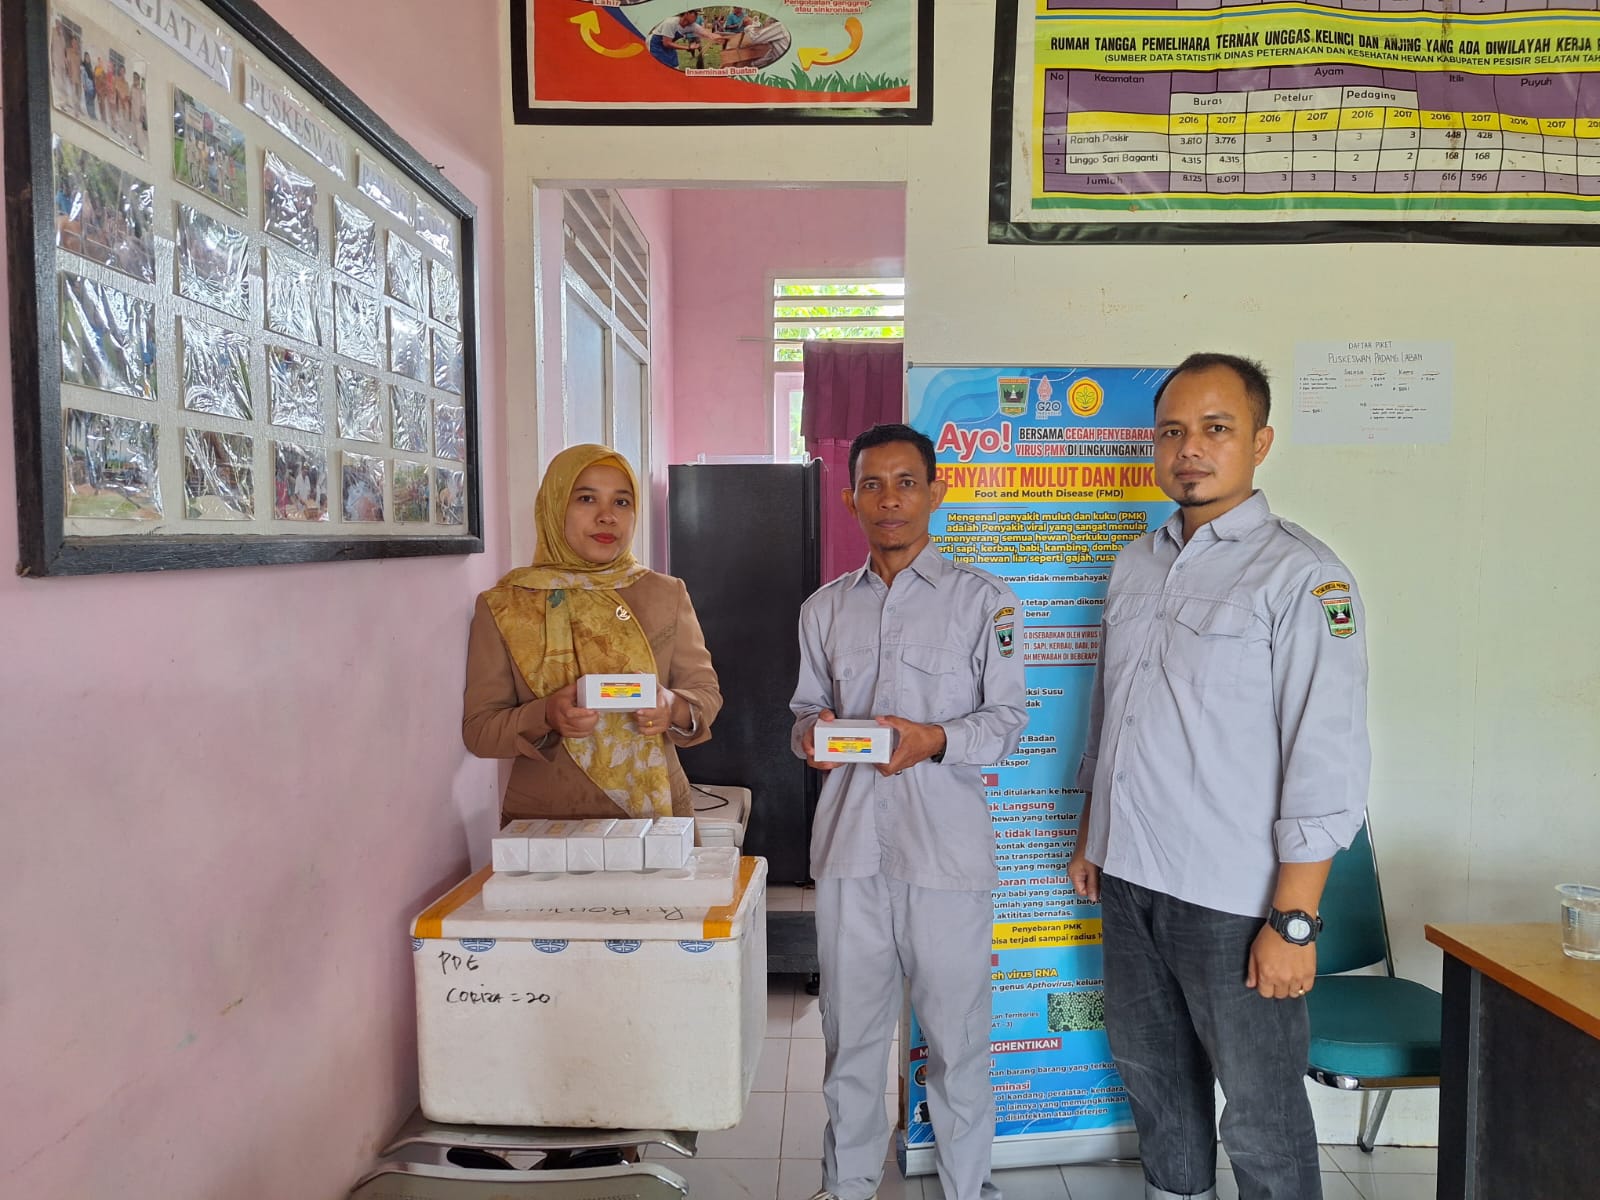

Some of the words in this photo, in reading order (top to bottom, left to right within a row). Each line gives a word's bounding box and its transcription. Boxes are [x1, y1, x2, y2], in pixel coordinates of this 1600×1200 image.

[124, 0, 227, 76] GIATAN
[1050, 36, 1089, 51] RUMAH
[1095, 36, 1137, 51] TANGGA
[1142, 36, 1210, 51] PEMELIHARA
[1216, 32, 1259, 49] TERNAK
[1264, 28, 1311, 46] UNGGAS
[1315, 29, 1354, 47] KELINCI
[1359, 35, 1379, 50] DAN
[1384, 36, 1421, 53] ANJING
[1426, 39, 1453, 54] YANG
[1459, 40, 1480, 55] ADA
[1486, 38, 1551, 56] DIWILAYAH
[1556, 37, 1591, 52] KERJA
[1104, 53, 1147, 63] (SUMBER
[1150, 53, 1173, 63] DATA
[1176, 52, 1223, 63] STATISTIK
[1223, 49, 1254, 60] DINAS
[1256, 46, 1324, 58] PETERNAKAN
[1326, 46, 1346, 55] DAN
[1348, 49, 1399, 61] KESEHATAN
[1401, 54, 1434, 63] HEWAN
[1436, 55, 1491, 66] KABUPATEN
[1493, 56, 1531, 67] PESISIR
[1534, 54, 1580, 64] SELATAN
[729, 67, 757, 76] Buatan
[1050, 73, 1064, 81] No
[1094, 74, 1145, 84] Kecamatan
[1314, 67, 1344, 78] Ayam
[1520, 77, 1552, 87] Puyuh
[1193, 97, 1222, 107] Buras
[1274, 93, 1314, 103] Petelur
[1346, 90, 1396, 101] Pedaging
[1179, 116, 1199, 124] 2016
[1216, 116, 1236, 124] 2017
[1260, 114, 1281, 122] 2016
[1307, 112, 1328, 120] 2017
[1351, 110, 1374, 119] 2016
[1393, 110, 1413, 118] 2017
[1430, 113, 1451, 121] 2016
[1472, 114, 1491, 122] 2017
[1547, 120, 1566, 128] 2017
[1070, 134, 1100, 144] Ranah
[1215, 136, 1237, 145] 3.776
[1477, 132, 1493, 140] 428
[1070, 155, 1099, 165] Linggo
[1102, 154, 1120, 163] Sari
[1122, 153, 1158, 164] Baganti
[1181, 156, 1202, 165] 4.315
[1219, 156, 1240, 164] 4.315
[1475, 152, 1490, 160] 168
[1442, 173, 1457, 181] 616
[1471, 173, 1487, 181] 596
[1328, 352, 1371, 364] PUSKESWAN
[1037, 401, 1061, 411] G20
[1020, 428, 1063, 440] BERSAMA
[1065, 428, 1095, 440] CEGAH
[1097, 428, 1155, 440] PENYEBARAN
[937, 423, 1011, 461] Ayo!
[1015, 444, 1043, 456] VIRUS
[1045, 444, 1065, 456] PMK
[1068, 444, 1077, 456] DI
[1080, 444, 1137, 456] LINGKUNGAN
[1139, 444, 1154, 456] KIT
[936, 467, 1016, 488] PENYAKIT
[1020, 467, 1078, 487] MULUT
[1082, 466, 1115, 487] DAN
[1056, 489, 1093, 497] Disease
[1096, 489, 1124, 498] (FMD)
[948, 512, 996, 522] Mengenal
[998, 512, 1039, 522] penyakit
[1042, 512, 1071, 520] mulut
[1073, 512, 1091, 520] dan
[1093, 512, 1116, 520] kuku
[1118, 512, 1146, 522] (PMK)
[946, 523, 979, 532] adalah
[981, 523, 1024, 533] Penyakit
[1026, 522, 1046, 531] viral
[1048, 524, 1073, 533] yang
[1075, 523, 1106, 532] sangat
[1108, 522, 1147, 531] menular
[944, 535, 999, 544] menyerang
[1001, 534, 1033, 542] semua
[1035, 533, 1068, 541] hewan
[1070, 533, 1109, 541] berkuku
[956, 544, 979, 553] sapi,
[981, 544, 1017, 553] kerbau,
[1019, 544, 1043, 553] babi,
[1044, 543, 1090, 553] kambing,
[977, 555, 1010, 563] hewan
[1012, 554, 1028, 562] liar
[1029, 554, 1063, 564] seperti
[1065, 554, 1095, 564] gajah,
[1026, 599, 1048, 608] tetap
[1042, 688, 1063, 696] Susu
[1000, 759, 1029, 767] Ekspor
[1004, 788, 1046, 797] ditularkan
[1002, 801, 1055, 811] Langsung
[992, 815, 1020, 823] hewan
[1022, 815, 1043, 824] yang
[1045, 813, 1077, 821] tertular
[1005, 829, 1031, 838] tidak
[996, 842, 1024, 850] kontak
[1028, 841, 1059, 850] dengan
[1011, 851, 1063, 861] transportasi
[1014, 865, 1034, 873] yang
[1030, 876, 1069, 885] melalui
[1009, 889, 1027, 897] babi
[1028, 888, 1049, 898] yang
[1052, 887, 1075, 897] dapat
[1022, 900, 1043, 909] yang
[1046, 899, 1074, 908] sangat
[1012, 924, 1061, 934] Penyebaran
[1063, 923, 1082, 931] PMK
[1010, 935, 1036, 945] terjadi
[1038, 934, 1068, 943] sampai
[1007, 970, 1033, 979] virus
[1035, 969, 1058, 977] RNA
[1000, 984, 1025, 992] genus
[1007, 1068, 1035, 1076] barang
[1038, 1066, 1066, 1074] barang
[1068, 1064, 1089, 1072] yang
[1007, 1103, 1037, 1111] lainnya
[1039, 1102, 1059, 1110] yang
[1061, 1096, 1125, 1107] memungkinkan
[1006, 1112, 1052, 1121] disinfektan
[1074, 1108, 1108, 1117] deterjen
